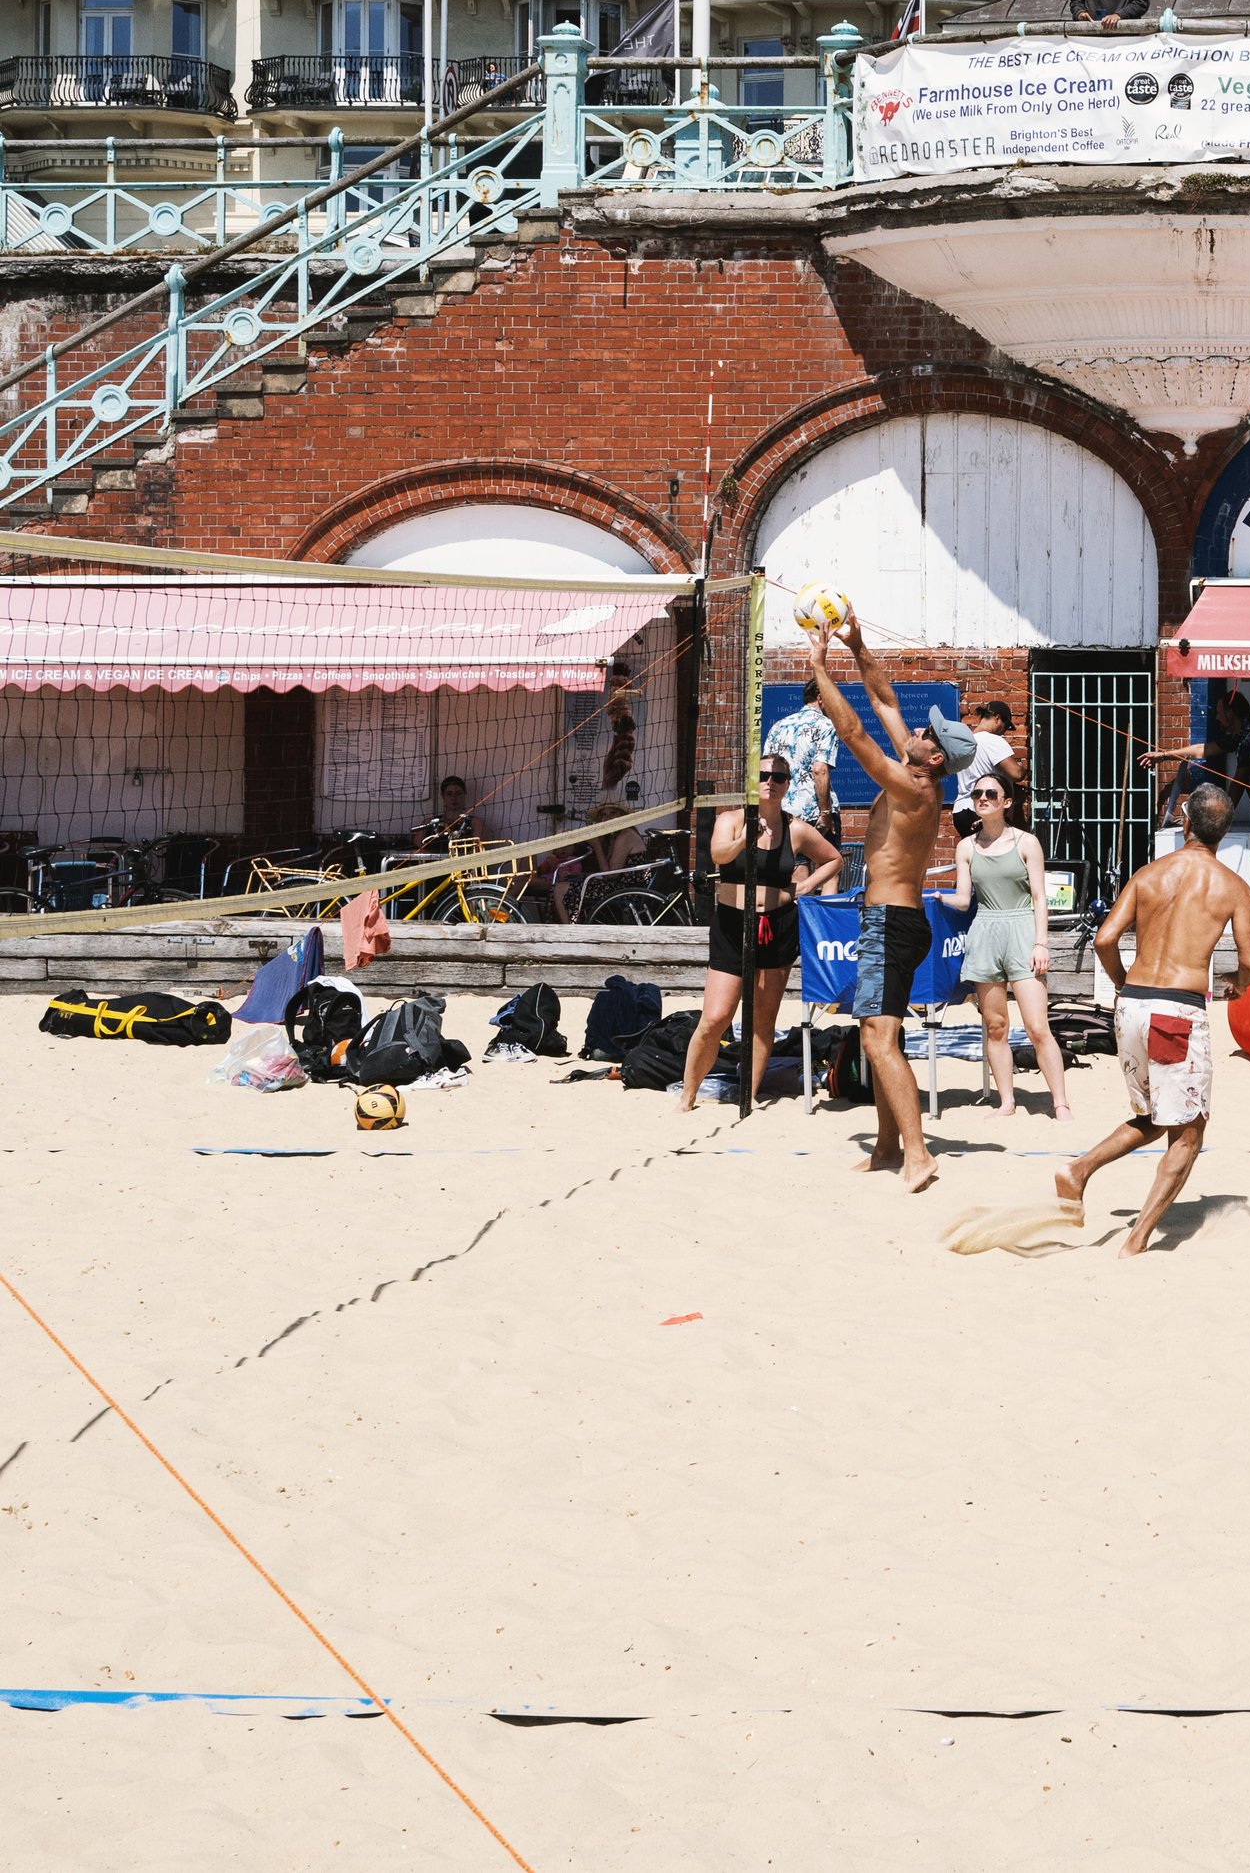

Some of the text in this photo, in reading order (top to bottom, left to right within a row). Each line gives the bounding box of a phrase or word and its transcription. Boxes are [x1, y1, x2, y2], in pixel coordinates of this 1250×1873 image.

[968, 56, 992, 70] THE
[997, 53, 1032, 68] BEST
[1036, 50, 1060, 66] ICE
[1065, 49, 1121, 63] CREAM
[1125, 50, 1147, 63] ON
[1150, 46, 1234, 63] BRIGHTON
[918, 76, 1114, 104] Farmhouse Ice Cream
[1126, 84, 1158, 95] taste
[1169, 83, 1193, 93] taste
[912, 95, 1120, 123] (We use Milk From Only One Herd)
[1201, 99, 1216, 111] 22
[1070, 127, 1093, 139] Best
[879, 136, 996, 163] REDROASTER
[1003, 140, 1104, 155] Independent Coffee
[11, 670, 32, 680] ICE
[35, 670, 81, 680] CREAM
[96, 670, 141, 680] VEGAN
[143, 669, 164, 679] ICE
[167, 669, 213, 679] CREAM
[233, 671, 261, 681] Chips
[272, 671, 303, 680] Pizzas
[313, 670, 352, 680] Coffees
[362, 670, 416, 680] Smoothies
[425, 669, 486, 680] Sandwiches
[494, 669, 536, 679] Toasties
[546, 670, 560, 679] Mr
[562, 670, 599, 681] Whippy
[753, 632, 764, 727] SPORTSET
